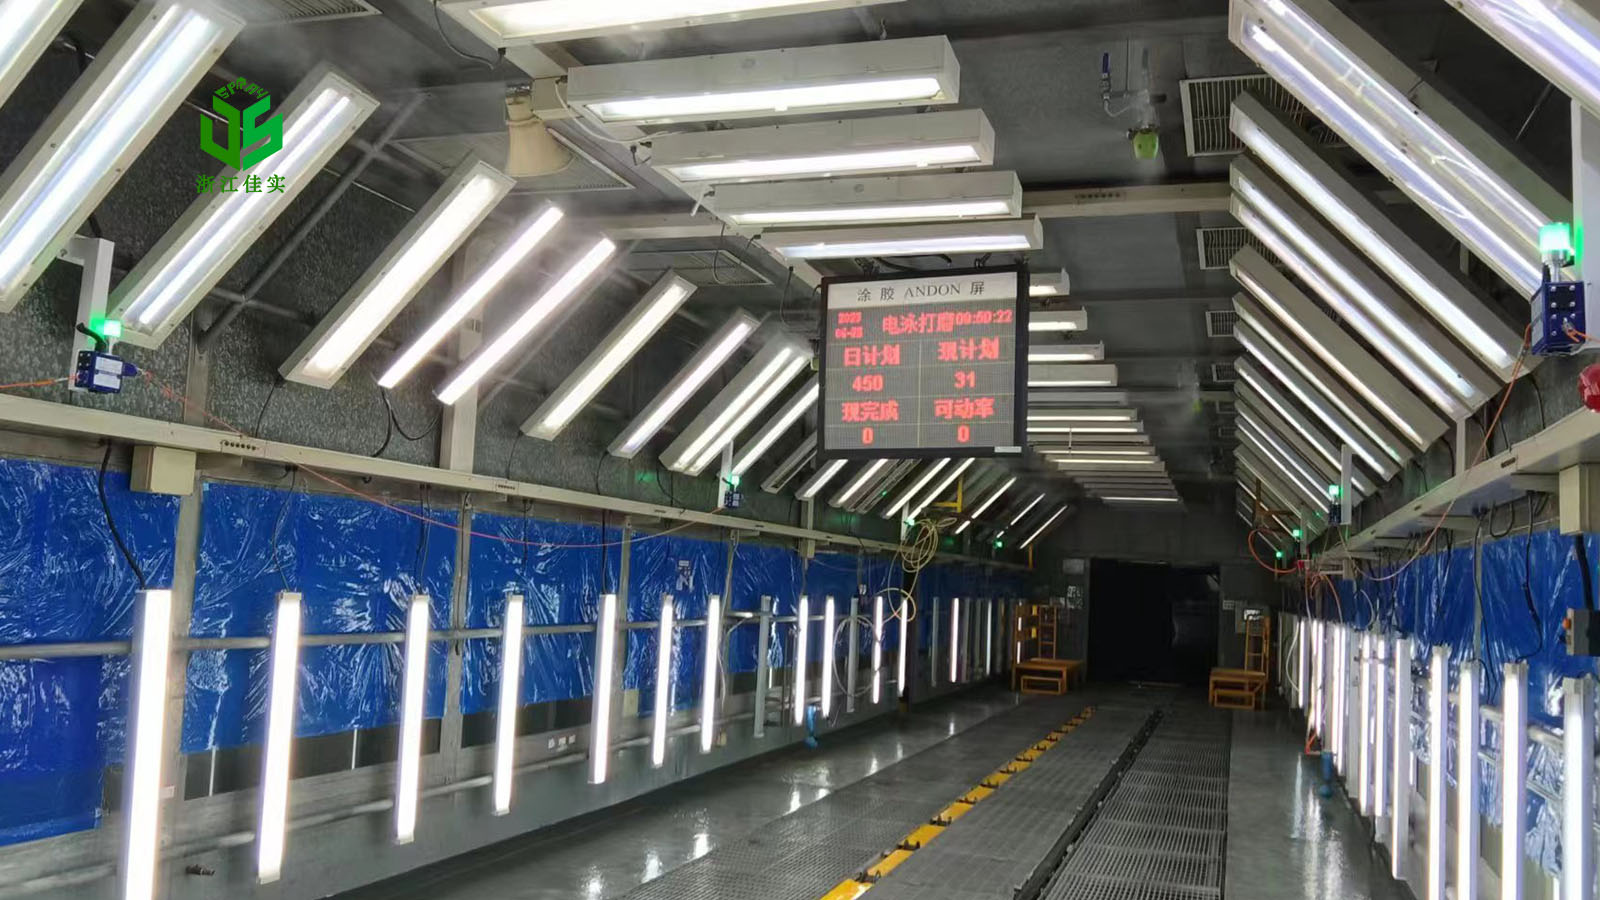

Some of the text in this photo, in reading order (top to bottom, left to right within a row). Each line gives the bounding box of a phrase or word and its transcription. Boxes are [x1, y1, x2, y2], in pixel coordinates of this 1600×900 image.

[903, 283, 961, 298] ANDON
[844, 344, 901, 366] 日计划
[852, 374, 884, 392] 450
[954, 371, 976, 389] 31
[841, 399, 899, 423] 现完成
[934, 397, 995, 419] 可动率
[862, 427, 875, 445] 0
[957, 424, 971, 443] 0
